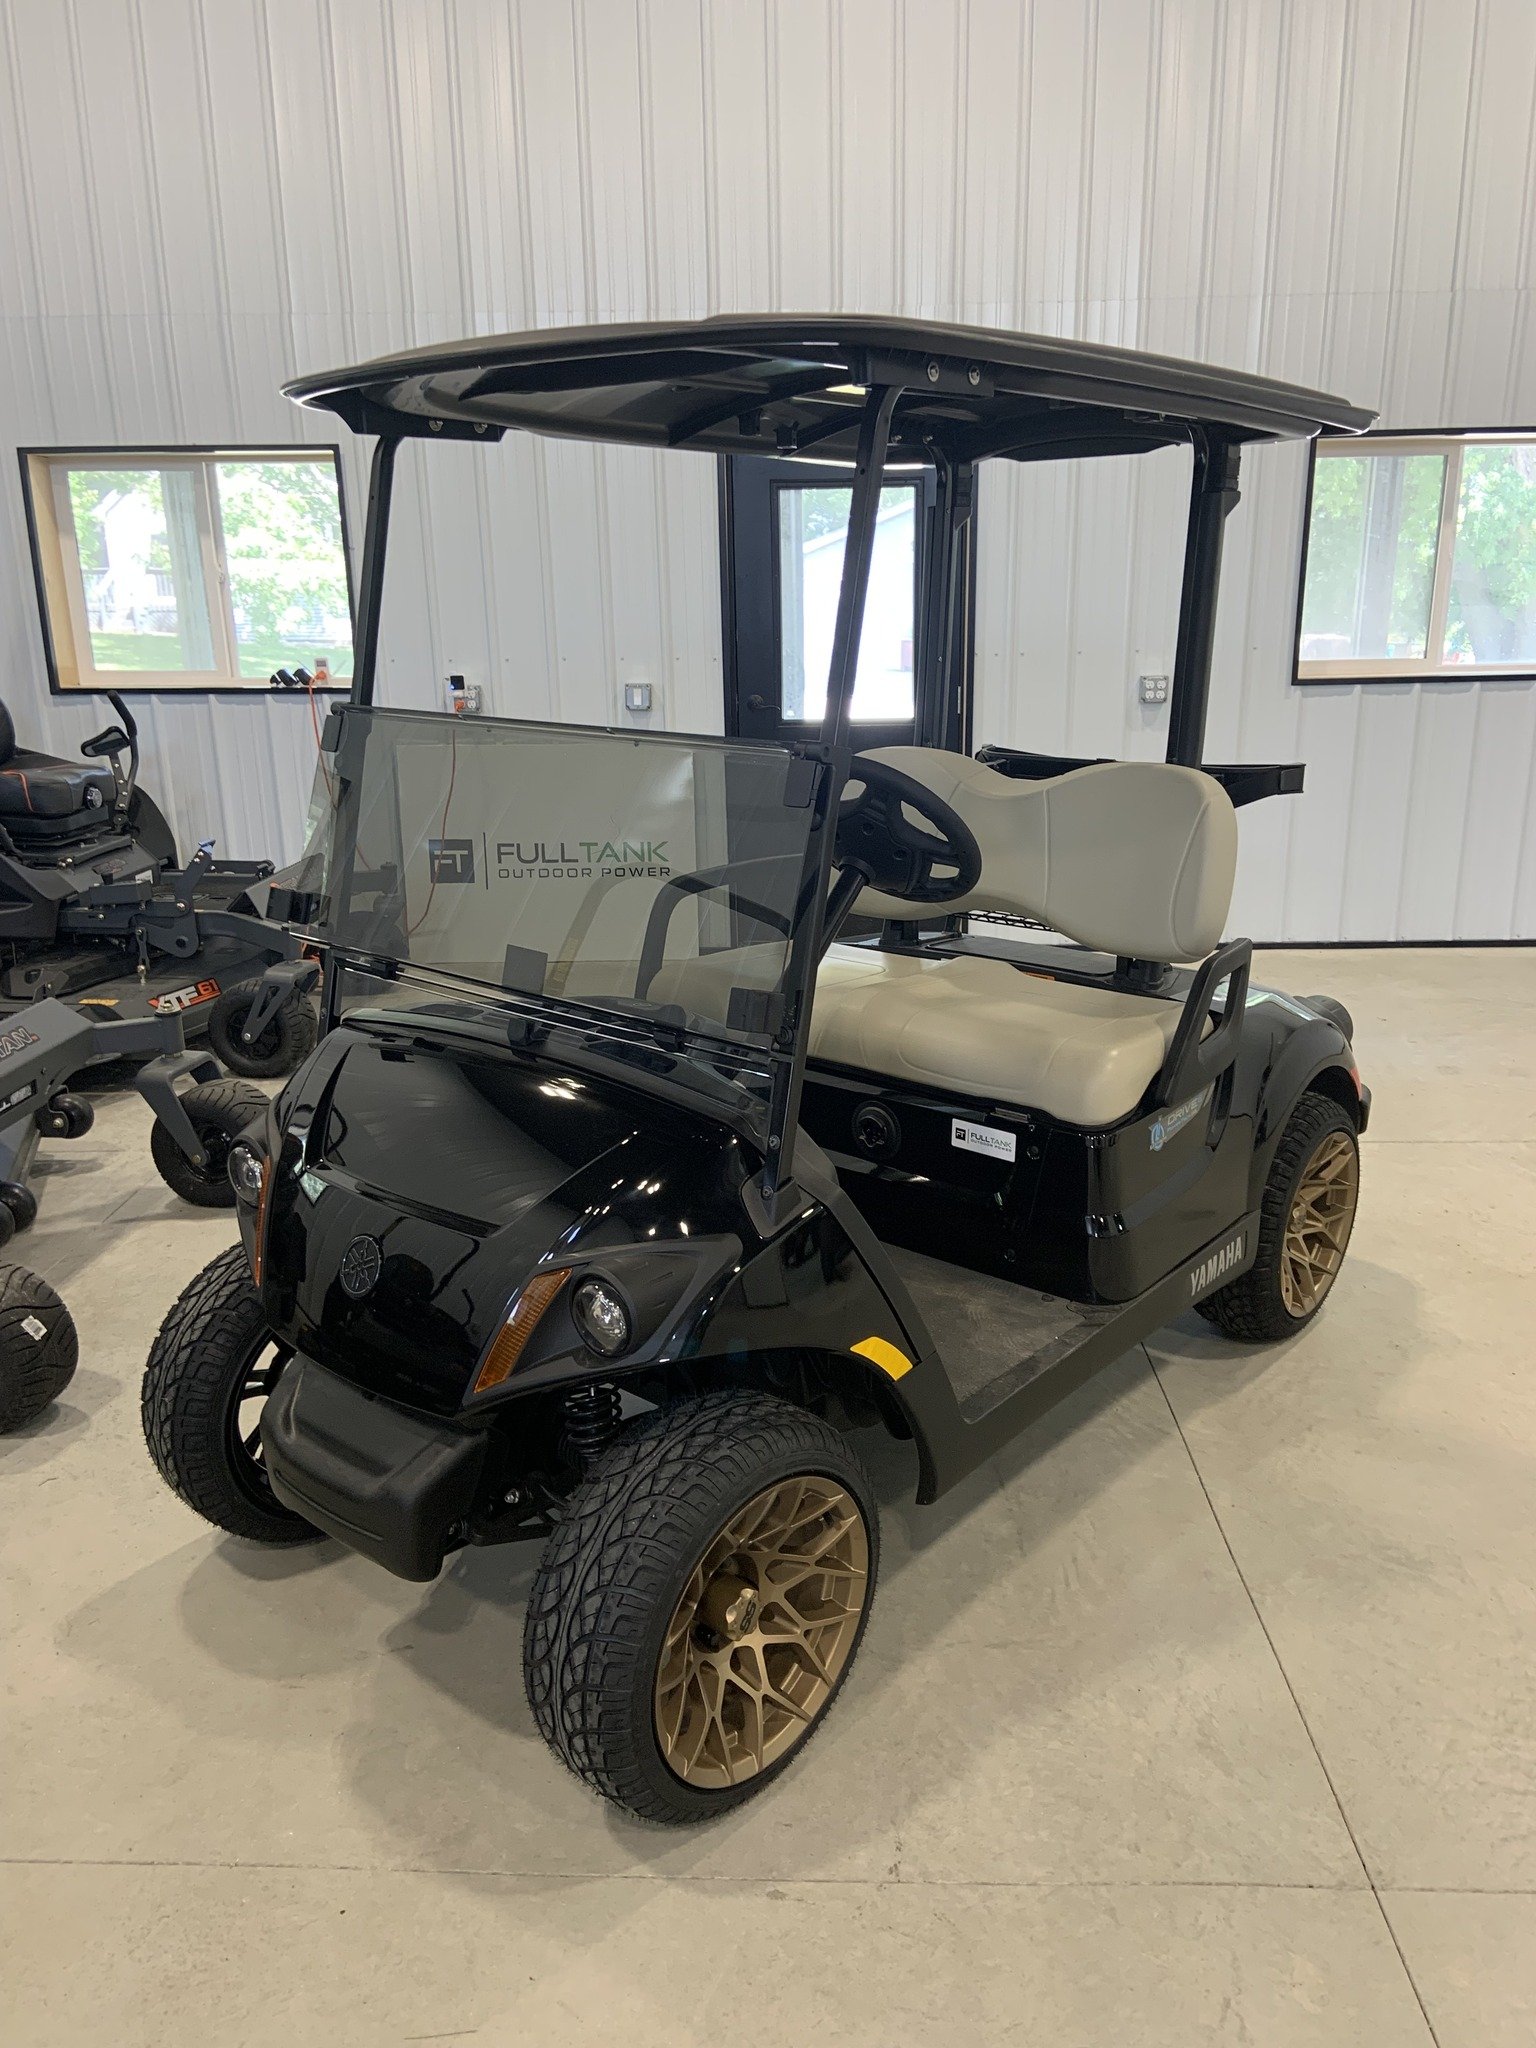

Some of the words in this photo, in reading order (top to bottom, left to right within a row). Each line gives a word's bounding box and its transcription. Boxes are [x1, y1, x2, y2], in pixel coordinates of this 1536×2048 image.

[432, 850, 469, 873] FT
[497, 841, 670, 864] FULLTANK
[498, 867, 592, 879] OUTDOOR
[601, 866, 671, 878] POWER
[198, 979, 220, 996] 61
[970, 1132, 1012, 1149] FULLTANK
[1190, 1236, 1243, 1297] YAMAHA
